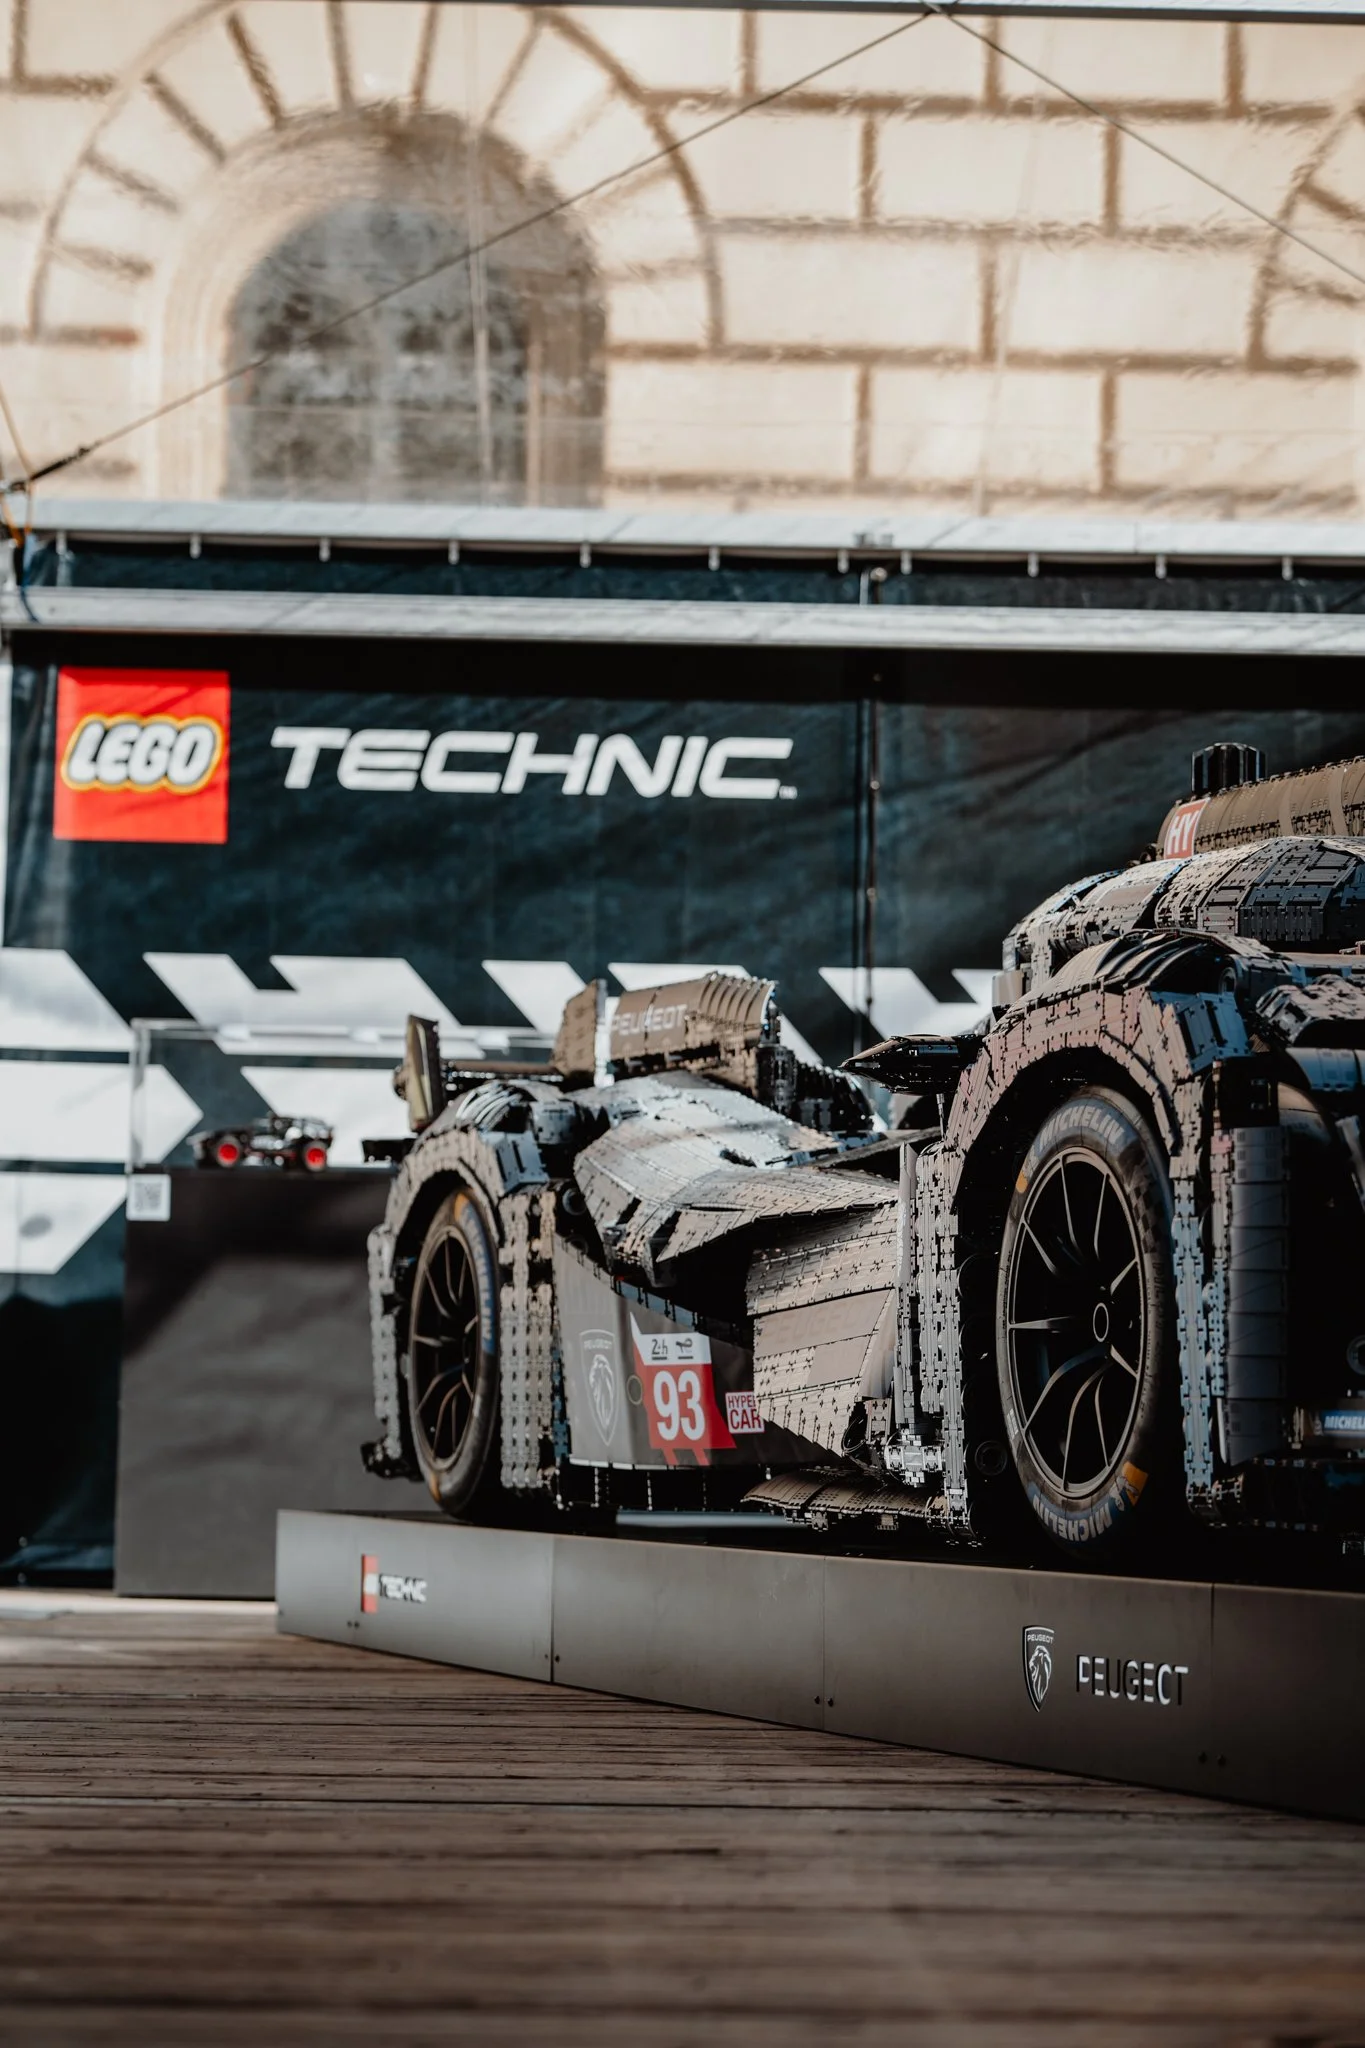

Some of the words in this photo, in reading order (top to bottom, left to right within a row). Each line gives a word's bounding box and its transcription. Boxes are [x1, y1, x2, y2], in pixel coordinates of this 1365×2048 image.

[67, 717, 220, 789] LEGO
[271, 725, 794, 799] TECHNIC
[1167, 809, 1200, 855] HY
[611, 1004, 688, 1036] PEUGEOT
[1039, 1105, 1125, 1152] MICHELIN
[652, 1369, 706, 1441] 93
[1032, 1493, 1113, 1542] MICHELIN
